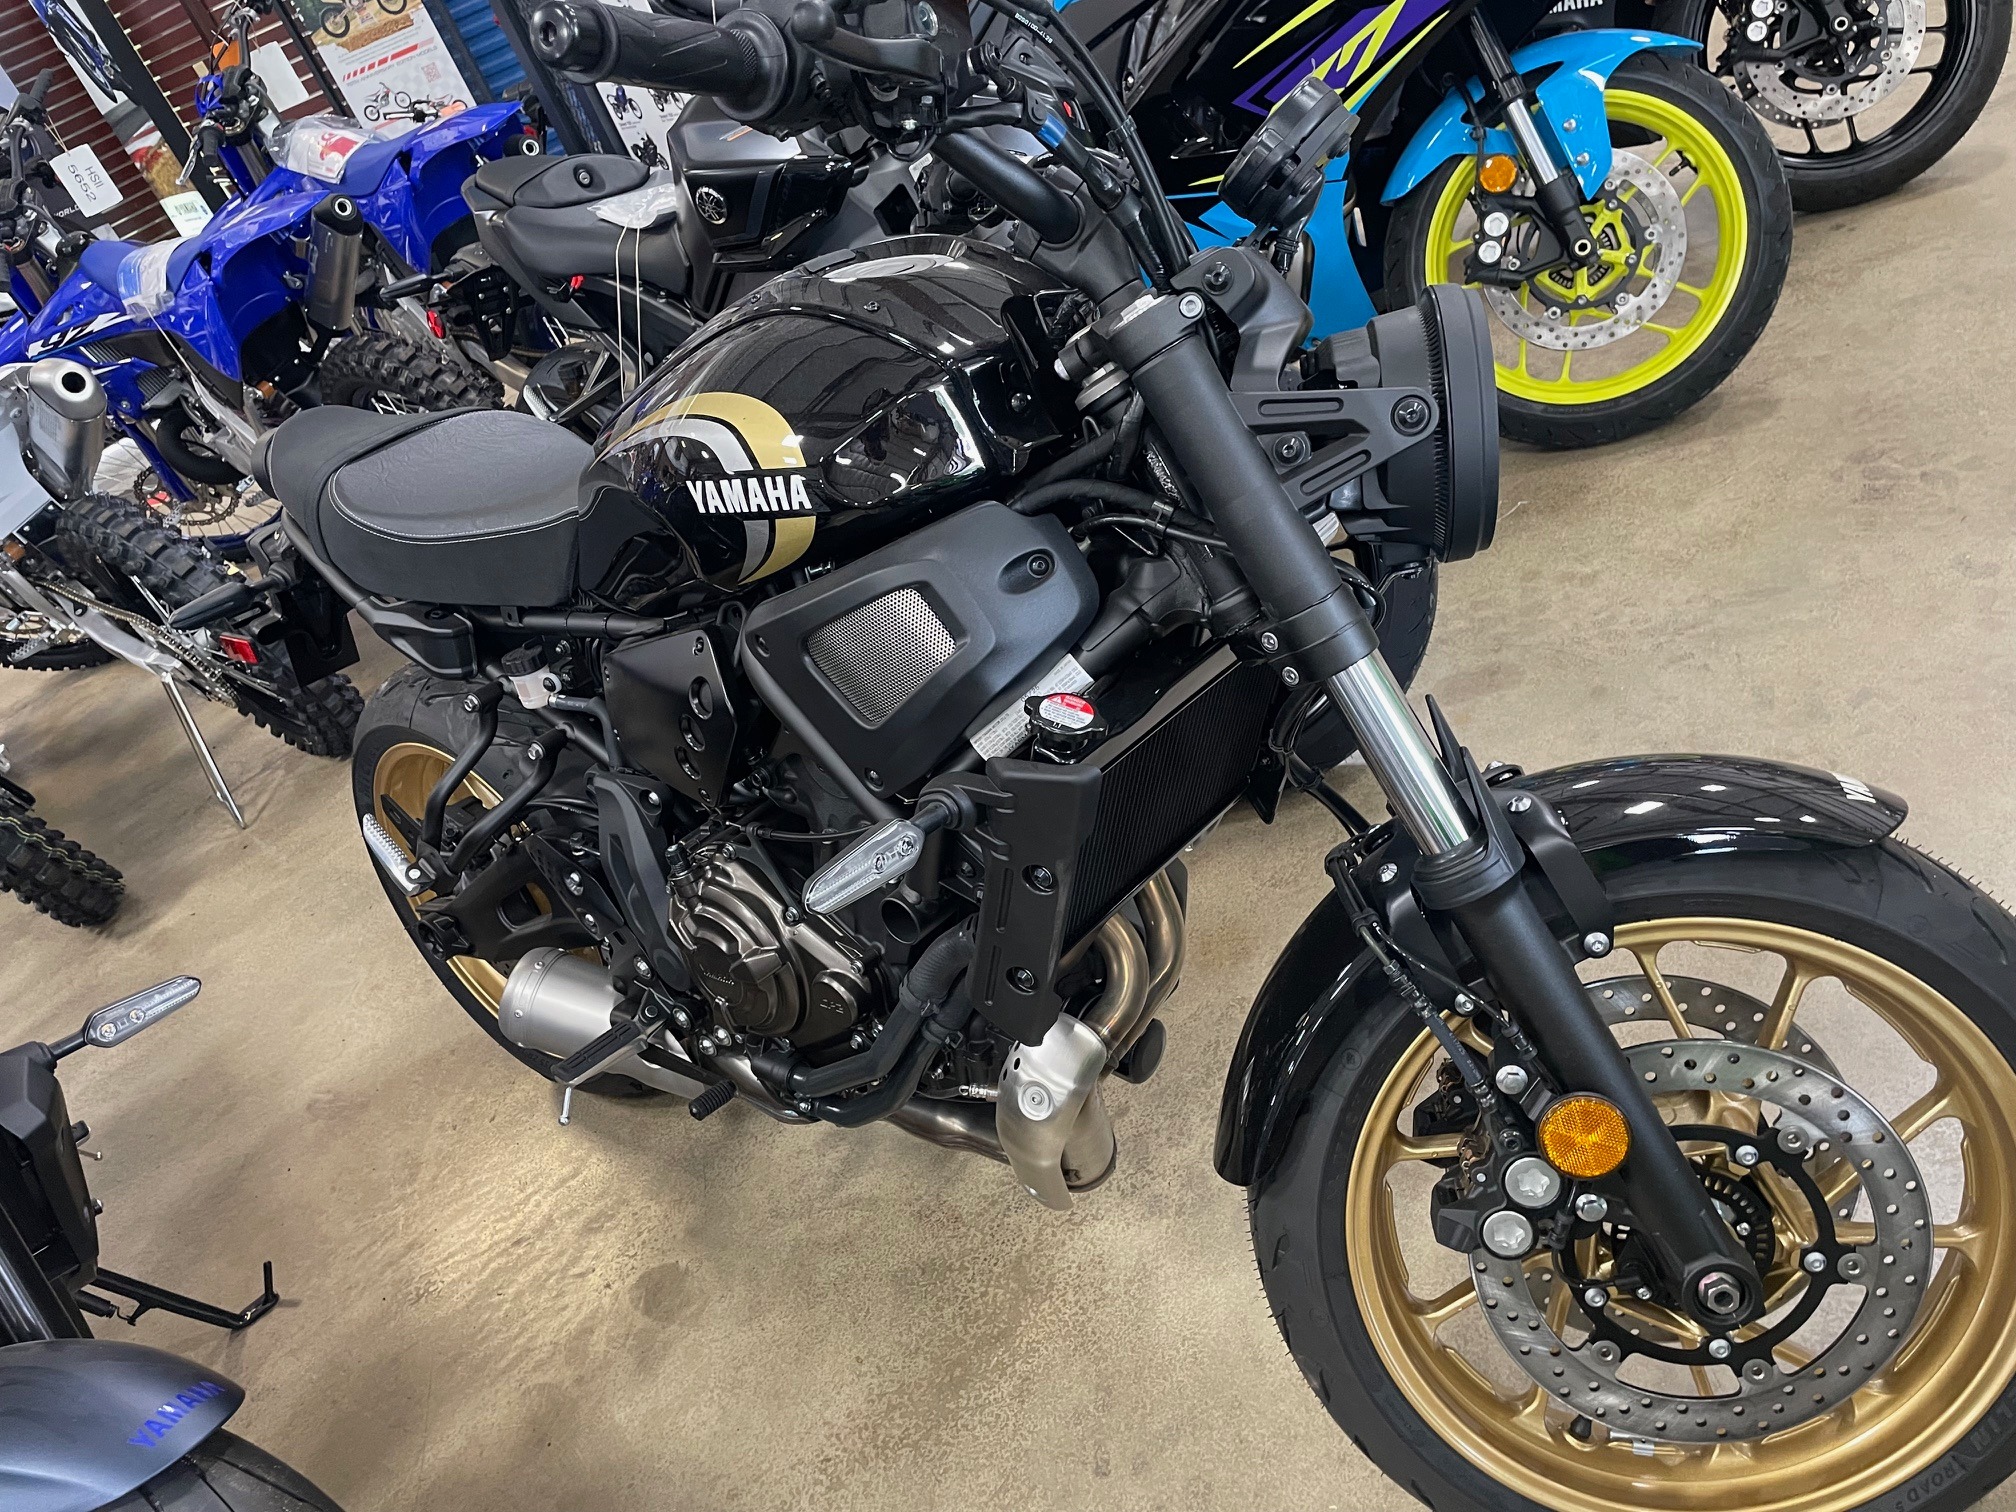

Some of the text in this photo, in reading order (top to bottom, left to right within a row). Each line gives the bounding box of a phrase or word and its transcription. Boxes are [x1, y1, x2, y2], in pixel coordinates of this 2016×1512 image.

[67, 164, 97, 202] 5652
[685, 474, 813, 514] YAMAHA
[127, 1381, 226, 1448] YAMAHA
